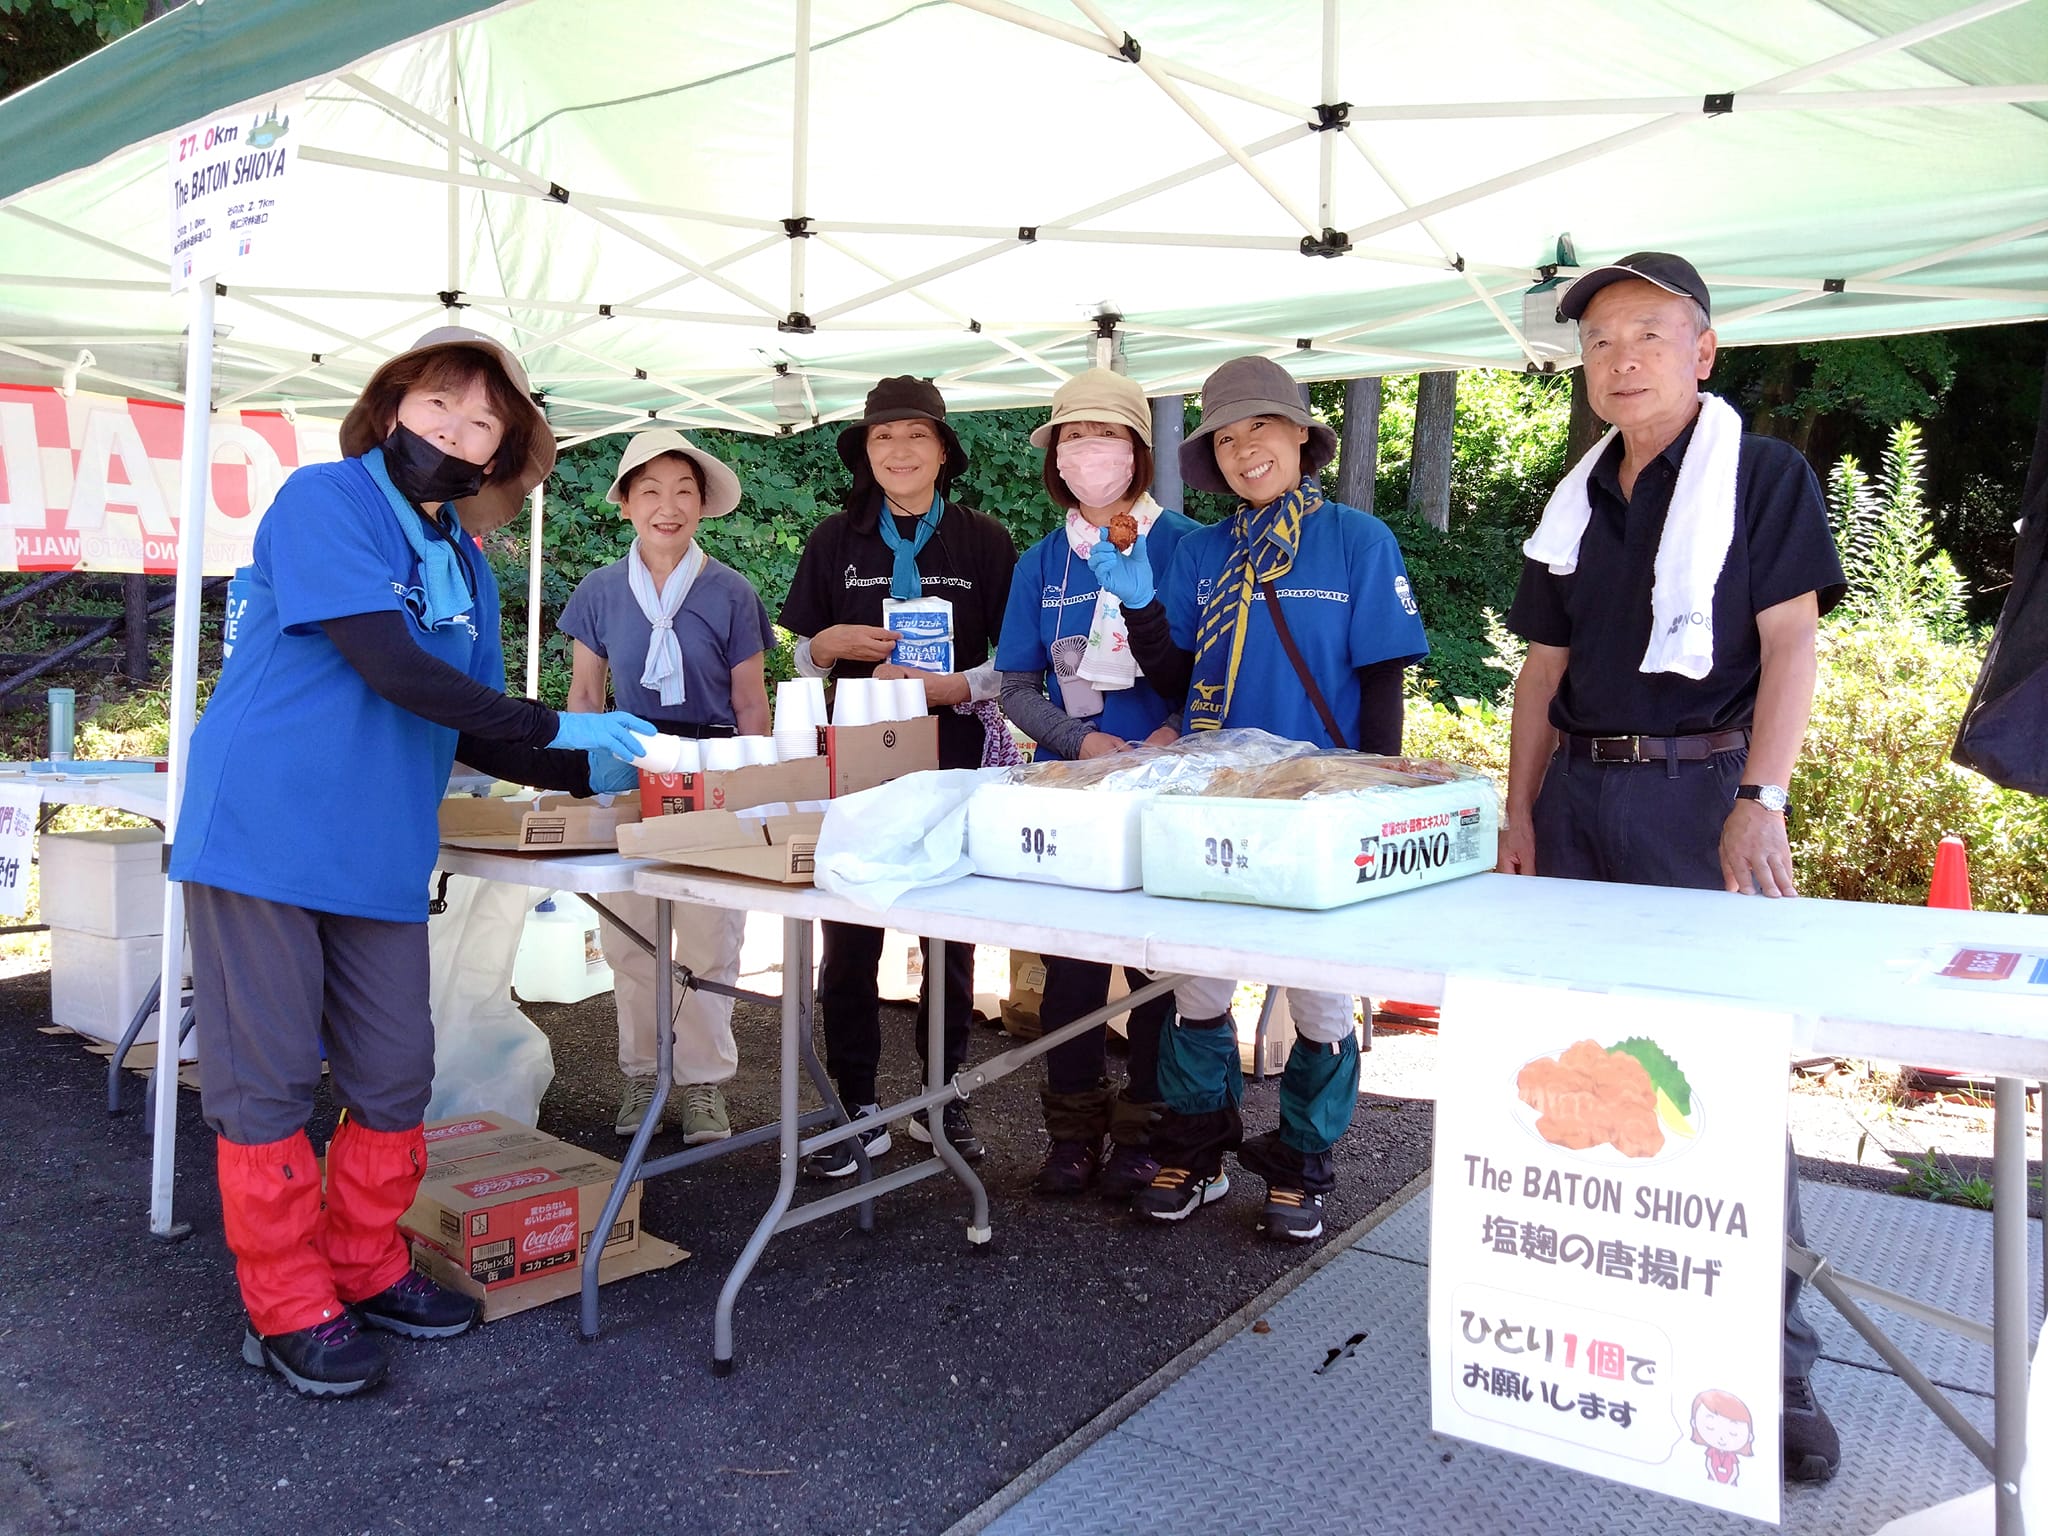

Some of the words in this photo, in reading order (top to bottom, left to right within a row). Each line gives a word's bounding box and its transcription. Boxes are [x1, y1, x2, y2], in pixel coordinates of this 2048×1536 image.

[174, 178, 188, 210] The
[191, 160, 231, 201] BATON
[233, 148, 286, 185] SHIOYA
[1316, 589, 1350, 603] WALK
[898, 651, 938, 661] SWEAT
[1021, 826, 1045, 855] 30
[1205, 837, 1233, 868] 30
[1355, 831, 1450, 884] EDONO
[1464, 1154, 1513, 1193] The
[1522, 1166, 1622, 1215] BATON
[1633, 1185, 1749, 1238] SHIOYA
[522, 1221, 577, 1253] Coca-Cola
[1481, 1214, 1723, 1297] 塩麹の唐揚げ
[525, 1252, 571, 1272] コカ・コーラ
[1460, 1309, 1657, 1386] ひとり1個で
[1462, 1361, 1637, 1429] お願いします
